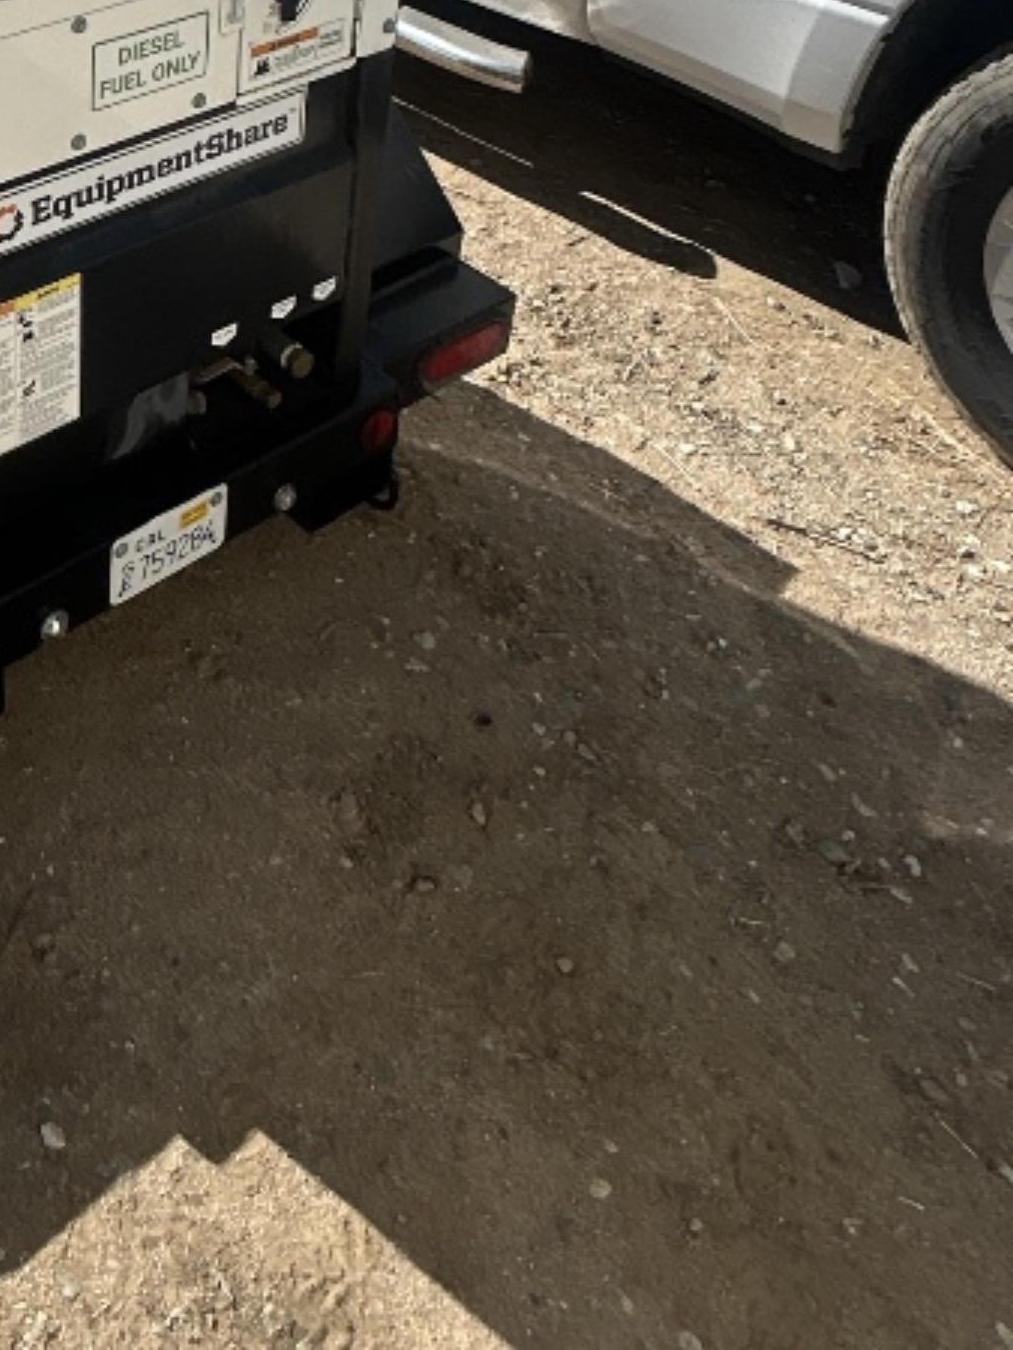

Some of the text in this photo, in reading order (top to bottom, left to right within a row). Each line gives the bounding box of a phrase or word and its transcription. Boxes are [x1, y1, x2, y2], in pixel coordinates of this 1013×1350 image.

[118, 29, 186, 67] DIESEL
[100, 50, 201, 100] FUEL ONLY
[30, 113, 289, 226] EquipmentShare
